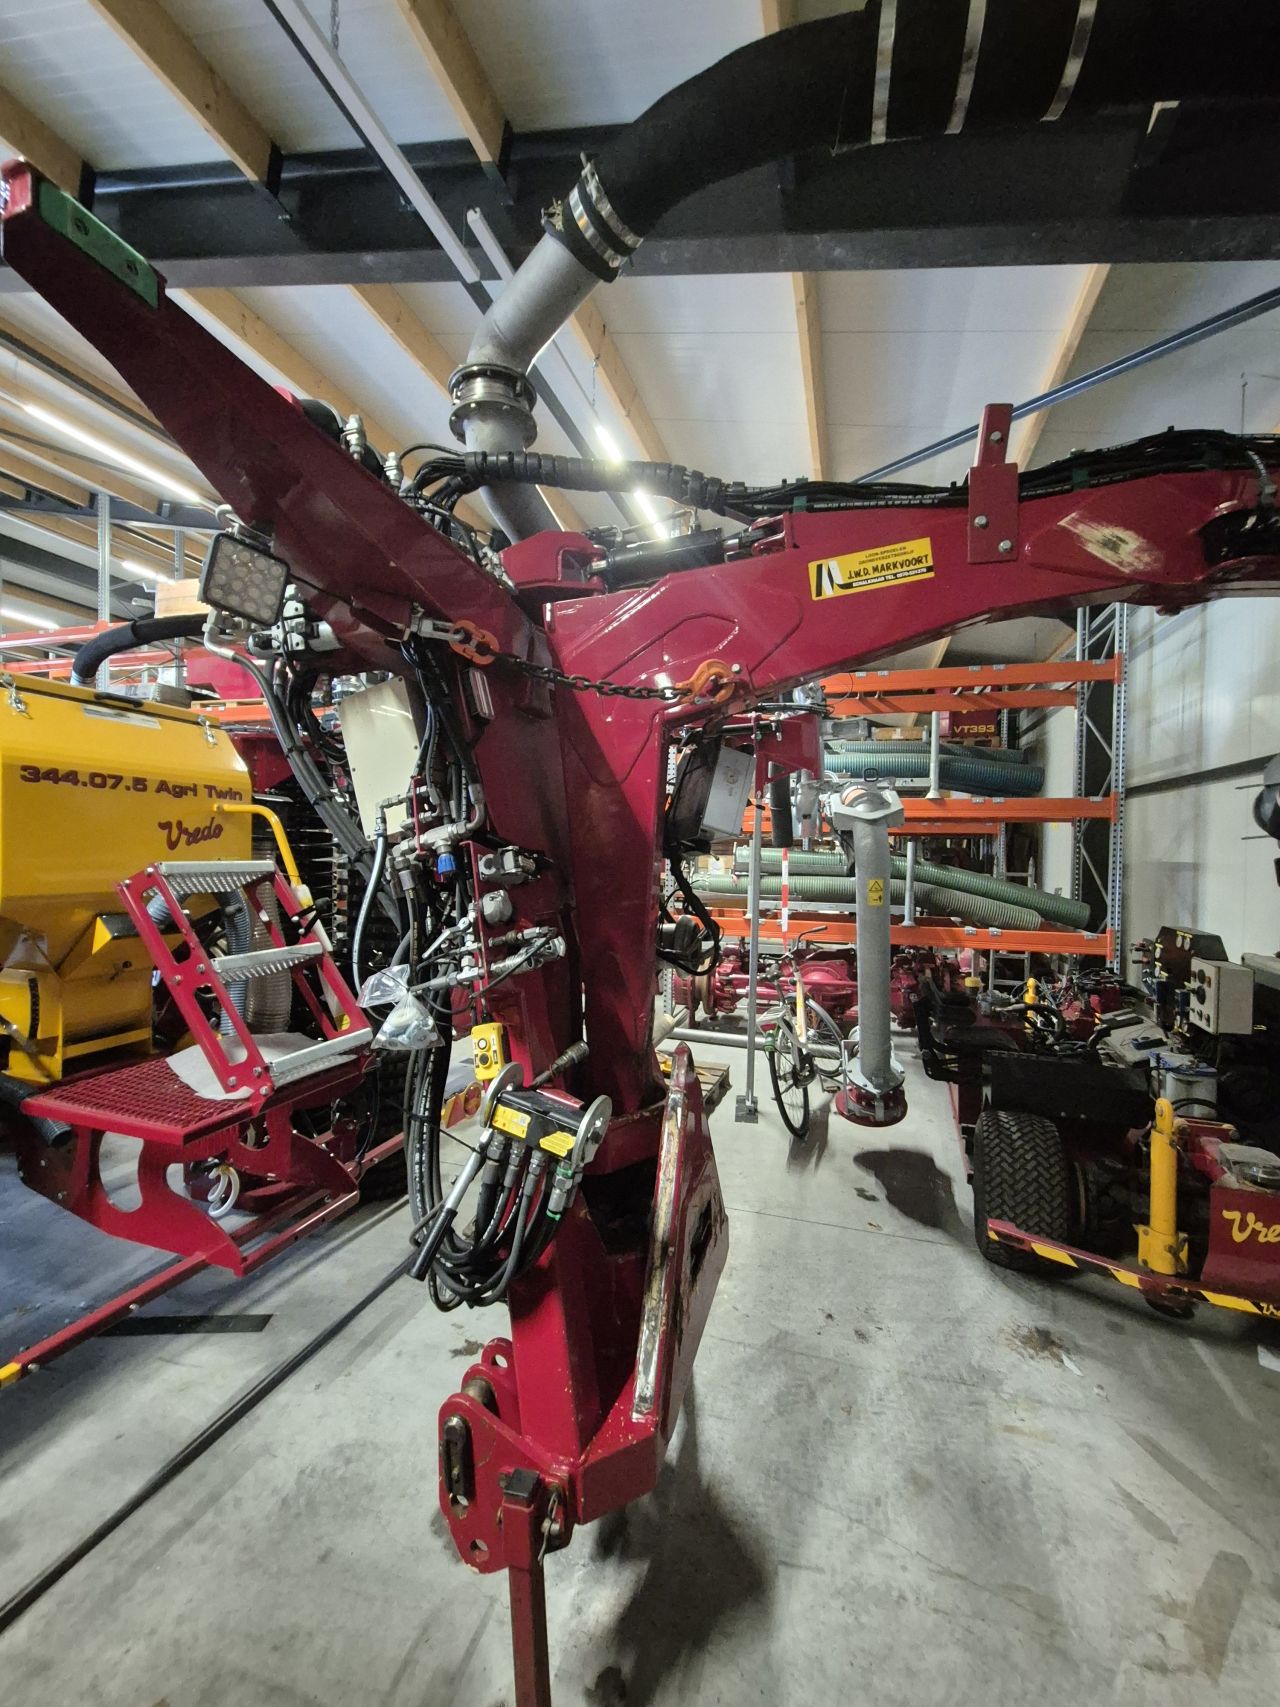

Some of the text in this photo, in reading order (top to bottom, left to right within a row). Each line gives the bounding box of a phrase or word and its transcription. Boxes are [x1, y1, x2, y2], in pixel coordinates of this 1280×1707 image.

[872, 554, 929, 575] MARKVOORT
[953, 724, 995, 734] VT393
[20, 764, 243, 802] 344.07.5 Agri Twin
[158, 816, 224, 851] Vredo
